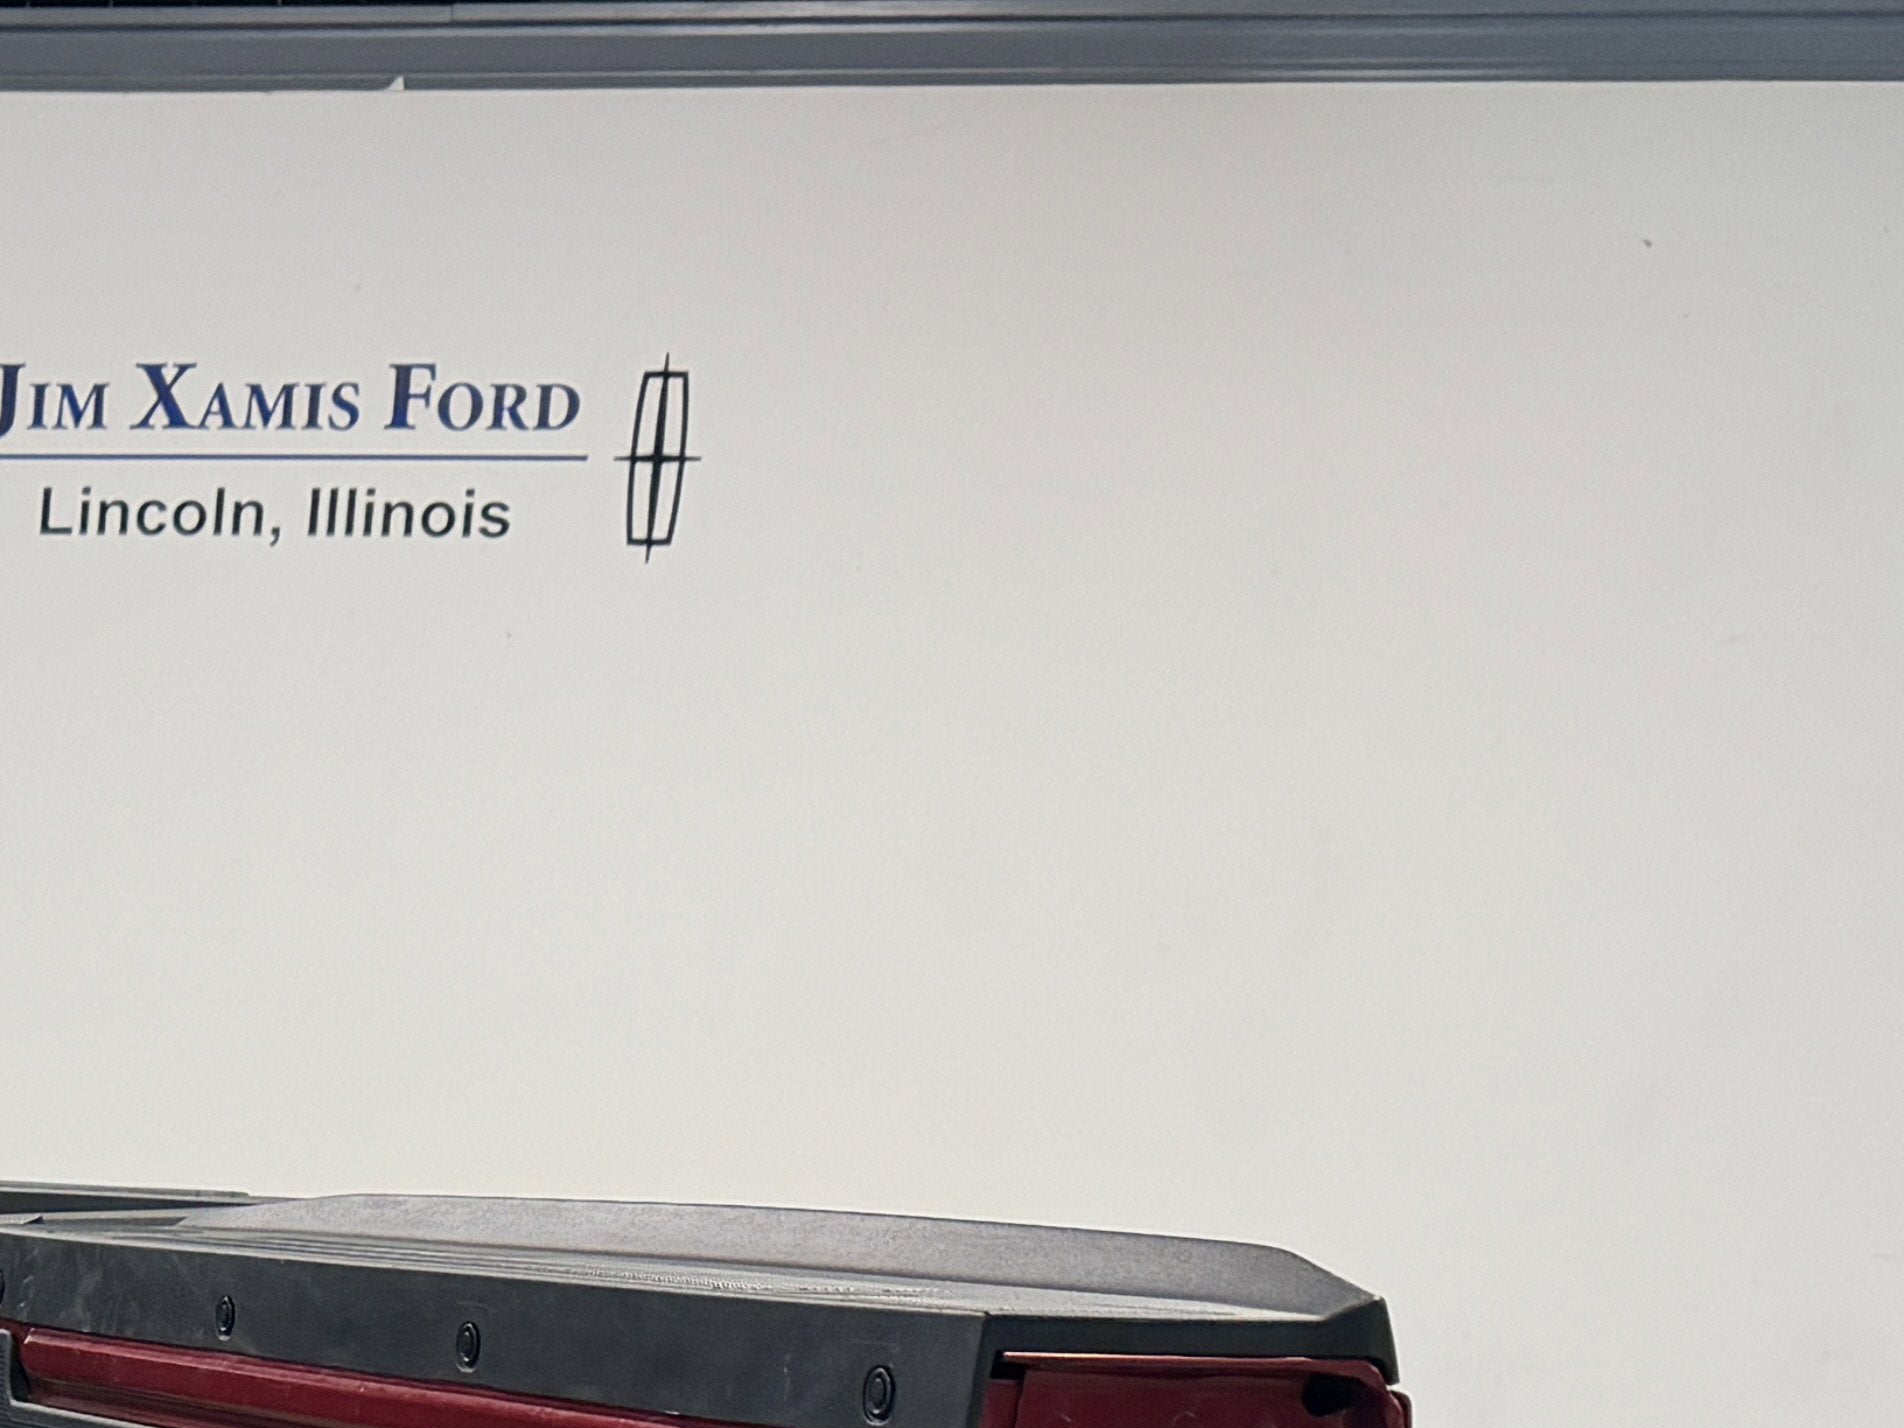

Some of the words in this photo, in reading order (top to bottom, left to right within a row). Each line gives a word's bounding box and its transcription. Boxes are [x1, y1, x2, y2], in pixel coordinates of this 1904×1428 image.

[129, 361, 360, 432] XAMIS
[387, 362, 581, 432] FORD
[40, 486, 282, 546] Lincoln,
[306, 486, 512, 540] Illinois
